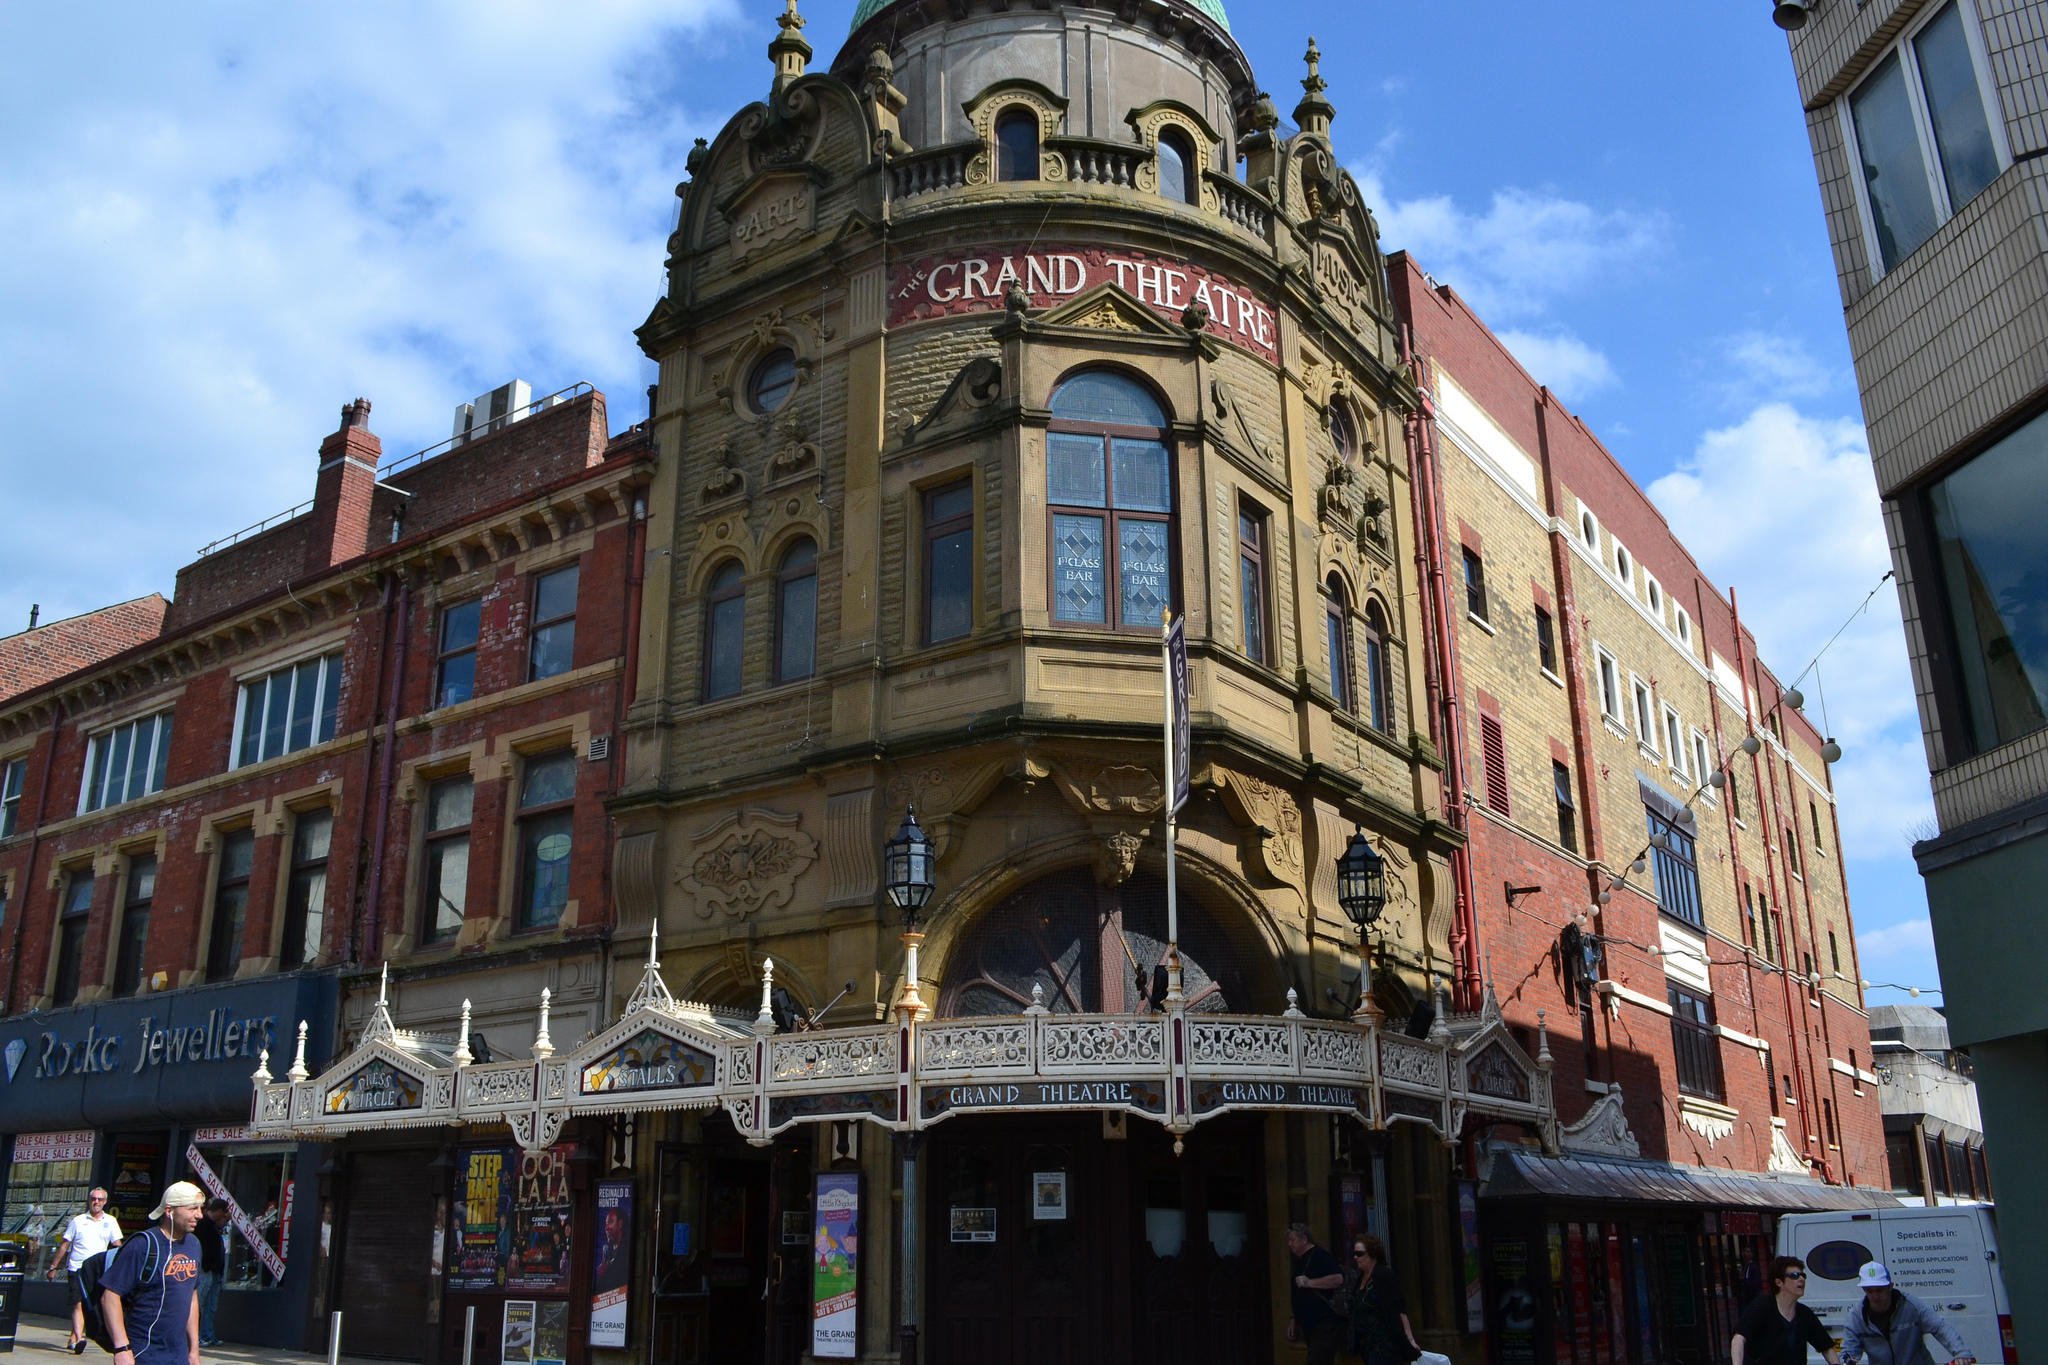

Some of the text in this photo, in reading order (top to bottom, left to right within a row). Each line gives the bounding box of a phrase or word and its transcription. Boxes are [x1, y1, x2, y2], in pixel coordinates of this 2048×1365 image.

[742, 195, 798, 242] ART
[1316, 242, 1361, 307] MUSIC
[897, 254, 1273, 351] THE GRAND THEATRE
[1067, 557, 1100, 568] CLASS
[1133, 562, 1165, 573] CLASS
[1066, 570, 1093, 581] BAR
[1132, 575, 1159, 586] BAR
[1175, 653, 1187, 777] GRAND
[133, 1007, 277, 1074] Jewellers
[619, 1065, 676, 1088] STALLS
[1484, 1075, 1513, 1095] CIRCLE
[353, 1090, 395, 1108] CIRCLE
[950, 1082, 1133, 1105] GRAND THEATRE
[1222, 1082, 1355, 1106] GRAND THEATRE
[16, 1132, 92, 1147] SALE SALE SALE SALE
[197, 1127, 243, 1139] SALE SALE
[15, 1147, 91, 1160] SALE SALE SALE SALE
[469, 1154, 503, 1178] STEP
[522, 1151, 566, 1180] OOH
[467, 1177, 500, 1199] BACK
[518, 1174, 569, 1202] LA LA
[598, 1188, 624, 1198] REGINALD
[188, 1147, 205, 1174] SALE
[206, 1173, 224, 1200] SALE
[244, 1223, 262, 1251] SALE
[262, 1249, 282, 1277] SALE
[598, 1198, 619, 1208] HUNTER
[820, 1198, 834, 1207] Little
[1896, 1229, 1958, 1240] Specialists in:
[1926, 1255, 1969, 1263] APPLICATIONS
[816, 1329, 856, 1338] THE GRAND
